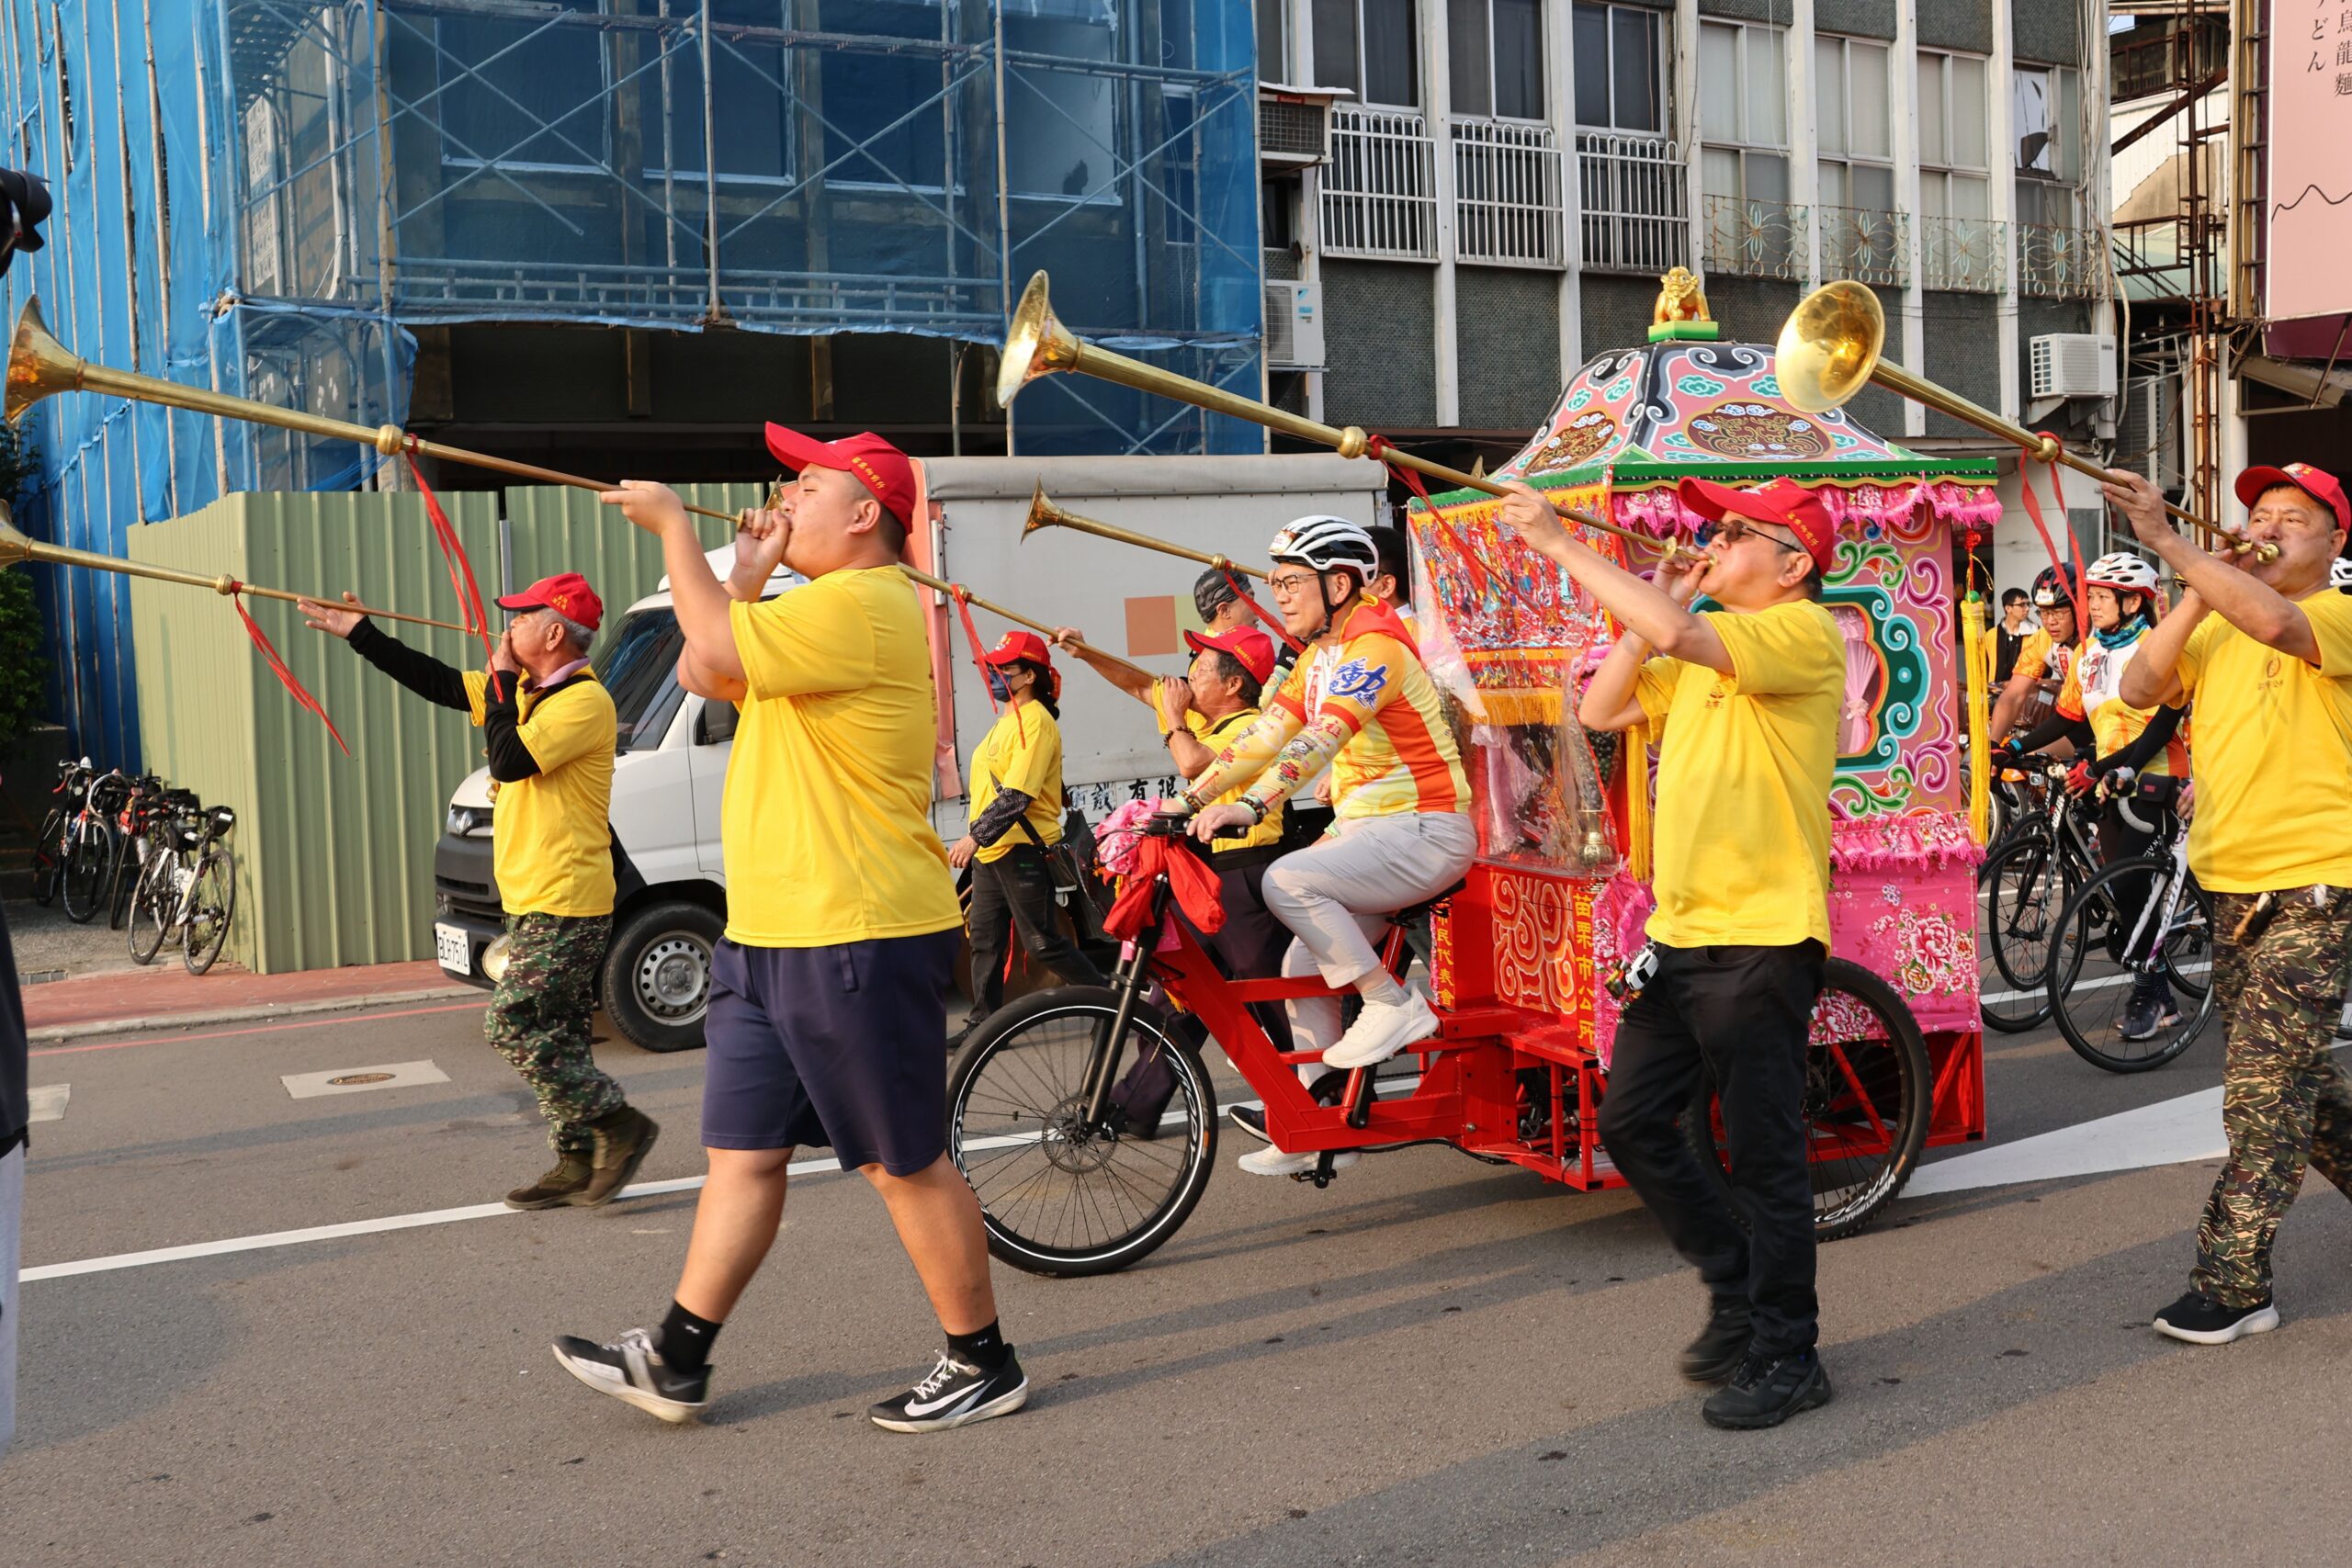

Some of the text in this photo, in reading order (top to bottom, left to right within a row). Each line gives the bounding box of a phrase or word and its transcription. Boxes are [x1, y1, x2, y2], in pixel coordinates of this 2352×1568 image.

[1573, 892, 1595, 1045] 苗栗市公所
